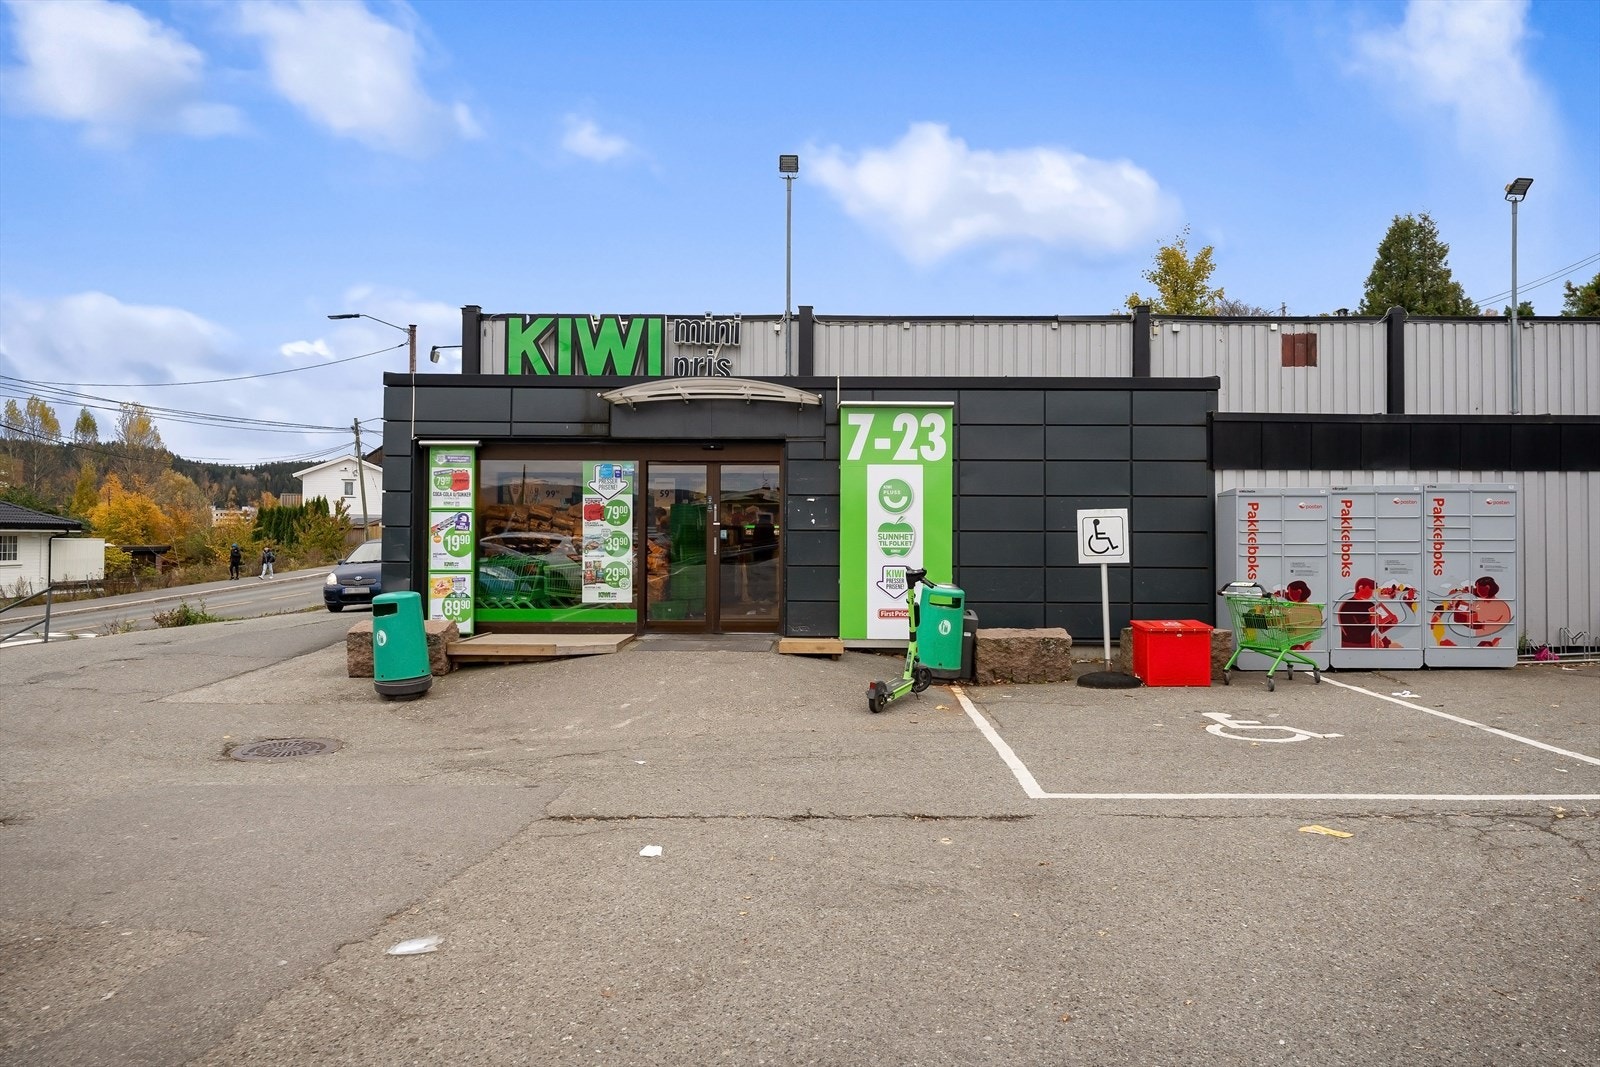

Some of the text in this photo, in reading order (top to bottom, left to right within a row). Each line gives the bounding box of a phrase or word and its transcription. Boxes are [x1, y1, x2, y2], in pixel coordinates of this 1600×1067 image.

[506, 316, 664, 376] KIWI
[673, 312, 742, 345] mini
[673, 349, 732, 376] pris
[847, 412, 947, 462] 7-23
[877, 533, 914, 541] SUNNHET
[1247, 502, 1259, 580] Pakkeboks
[1341, 500, 1353, 578] Pakkeboks
[1433, 498, 1445, 576] Pakkeboks
[886, 569, 905, 577] KIWI
